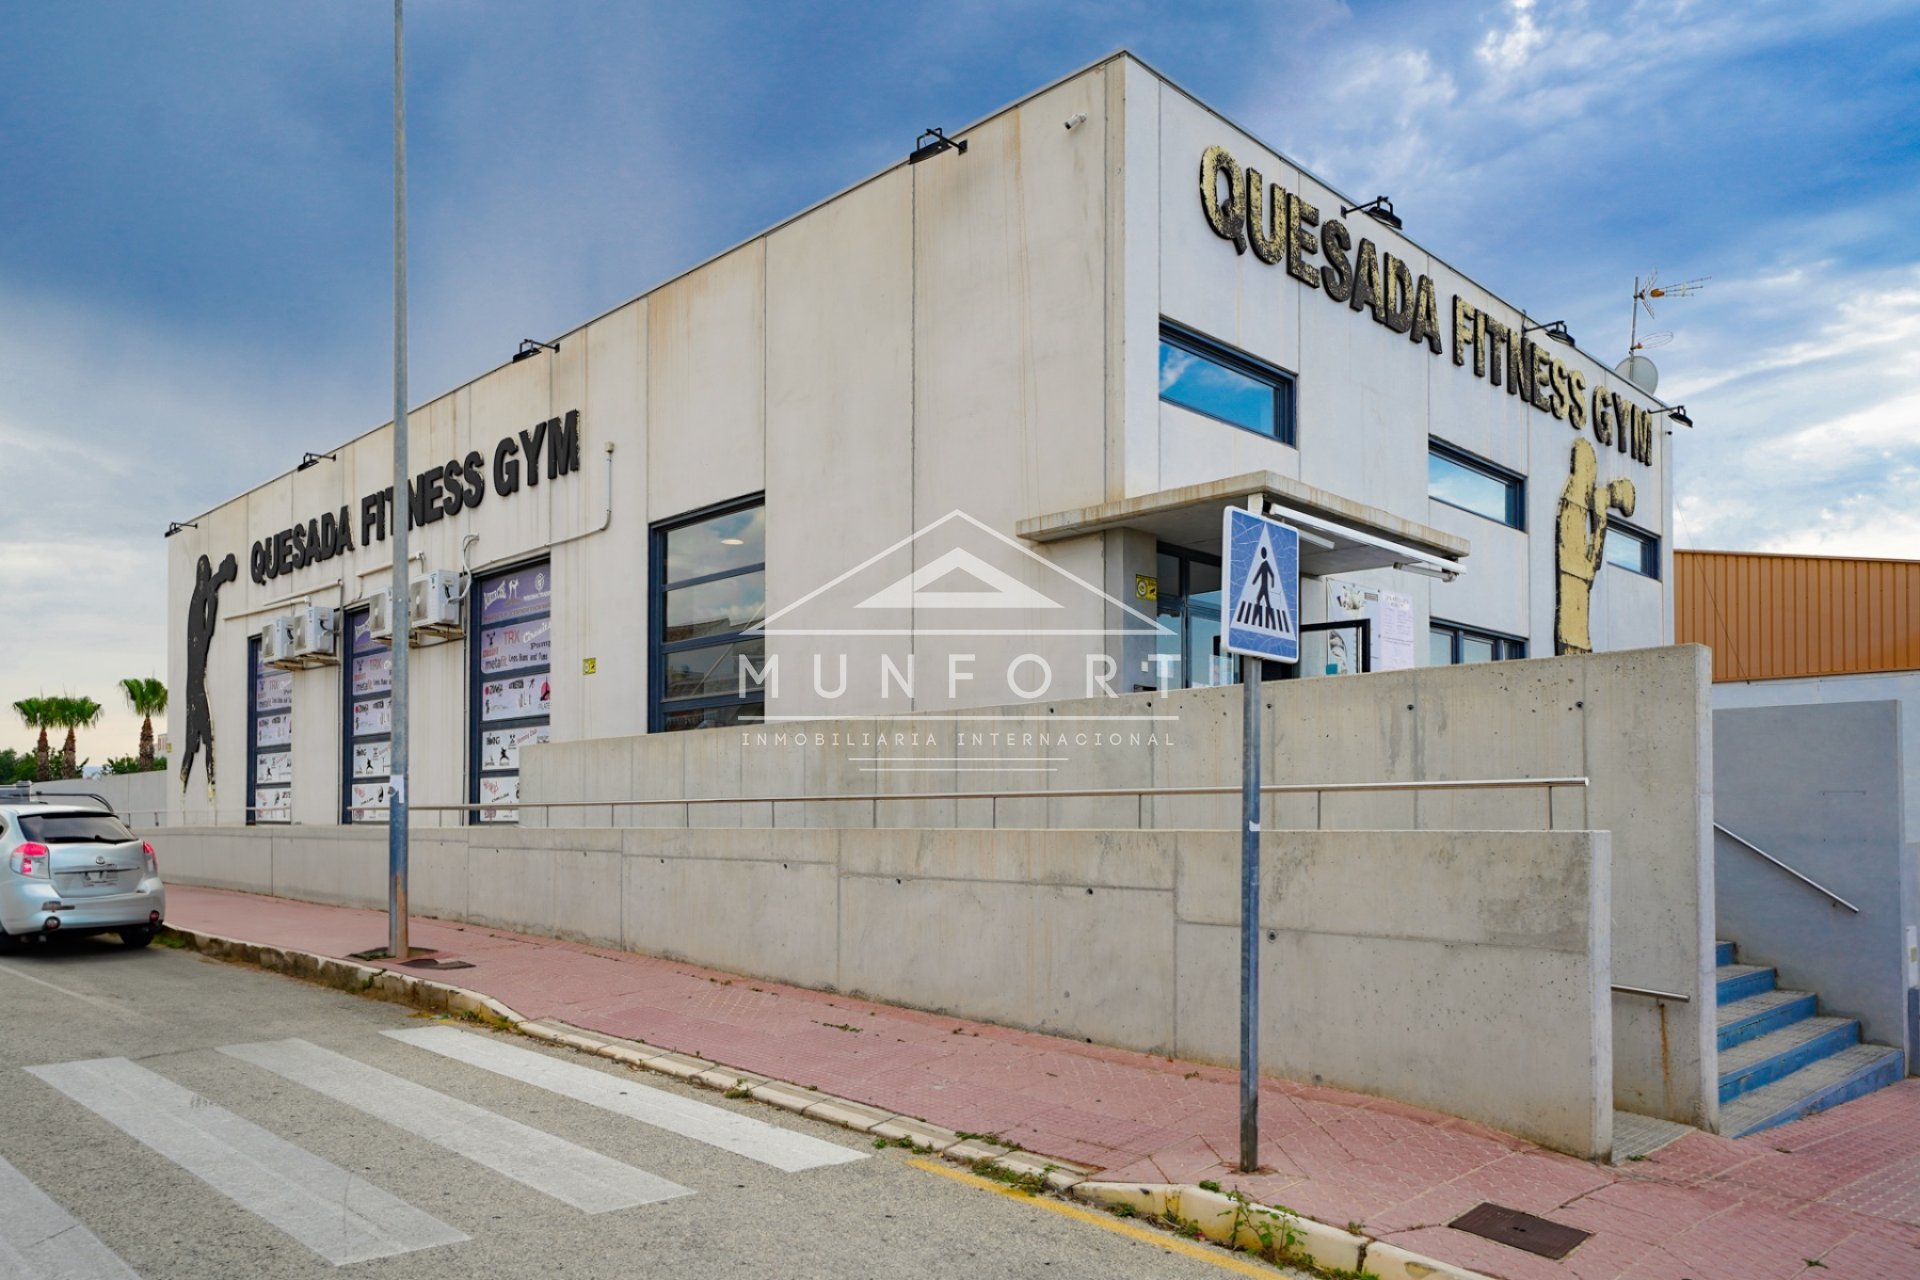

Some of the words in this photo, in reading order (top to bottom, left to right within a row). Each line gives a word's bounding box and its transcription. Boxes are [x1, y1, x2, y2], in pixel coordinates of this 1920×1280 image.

[1200, 145, 1443, 355] QUESADA
[1452, 293, 1588, 431] FITNESS
[1592, 384, 1653, 467] GYM
[251, 504, 355, 586] QUESADA
[493, 408, 580, 497] GYM
[503, 629, 520, 645] TRX
